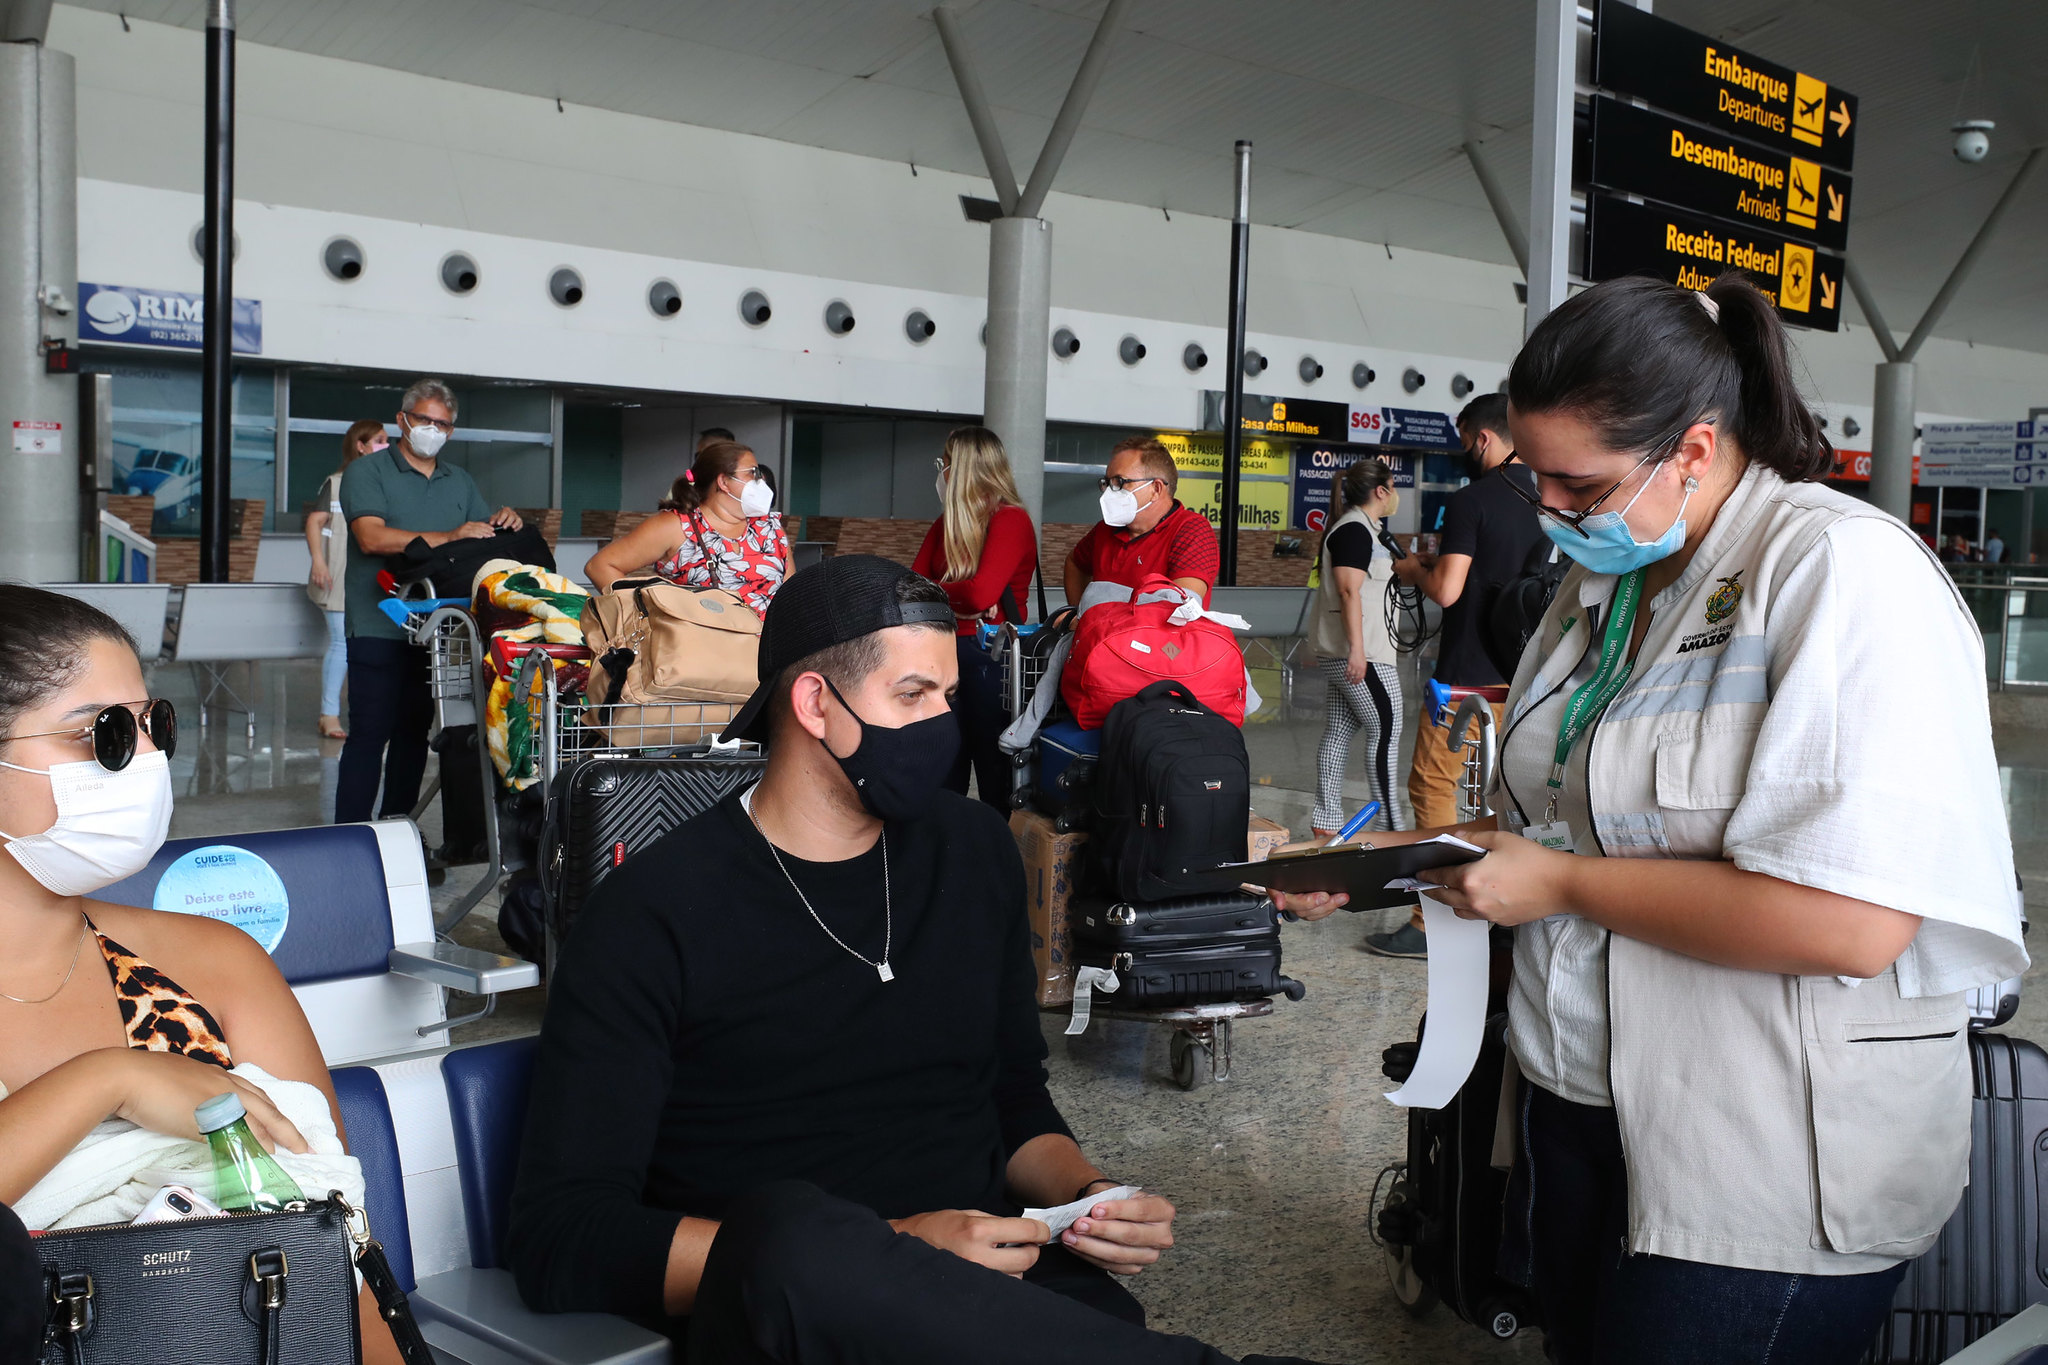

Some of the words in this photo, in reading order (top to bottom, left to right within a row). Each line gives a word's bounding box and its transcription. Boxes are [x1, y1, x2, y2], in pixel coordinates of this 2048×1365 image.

[1705, 47, 1788, 103] Embarque
[1718, 88, 1786, 134] Departures
[1670, 129, 1784, 191] Desembarque
[1736, 190, 1781, 223] Arrivals
[1666, 223, 1723, 263] Receita
[1726, 239, 1780, 277] Federal
[1676, 265, 1716, 292] Adua
[137, 295, 203, 323] RIM
[151, 330, 168, 340] (92)
[170, 331, 203, 342] 3652-1
[1265, 419, 1285, 432] das
[1286, 421, 1319, 435] Milhas
[1351, 412, 1381, 430] SOS
[1188, 444, 1197, 454] DE
[1198, 444, 1223, 456] PASSAG
[1175, 457, 1220, 467] 99143-4345
[1240, 461, 1268, 470] 43-4341
[1854, 455, 1872, 476] GO
[1300, 469, 1335, 480] PASSAGEN
[1615, 567, 1640, 630] WWW.FVS.AM.GOV.
[1676, 631, 1733, 654] AMAZON
[1565, 695, 1585, 733] FUNDAÇÃO
[1581, 690, 1590, 699] DE
[1607, 639, 1618, 660] SAÚDE
[1609, 684, 1617, 693] DE
[194, 855, 224, 865] CUIDE
[184, 893, 224, 905] Deixe
[228, 890, 256, 901] este
[233, 904, 267, 916] livre,
[143, 1250, 191, 1266] SCHUTZ
